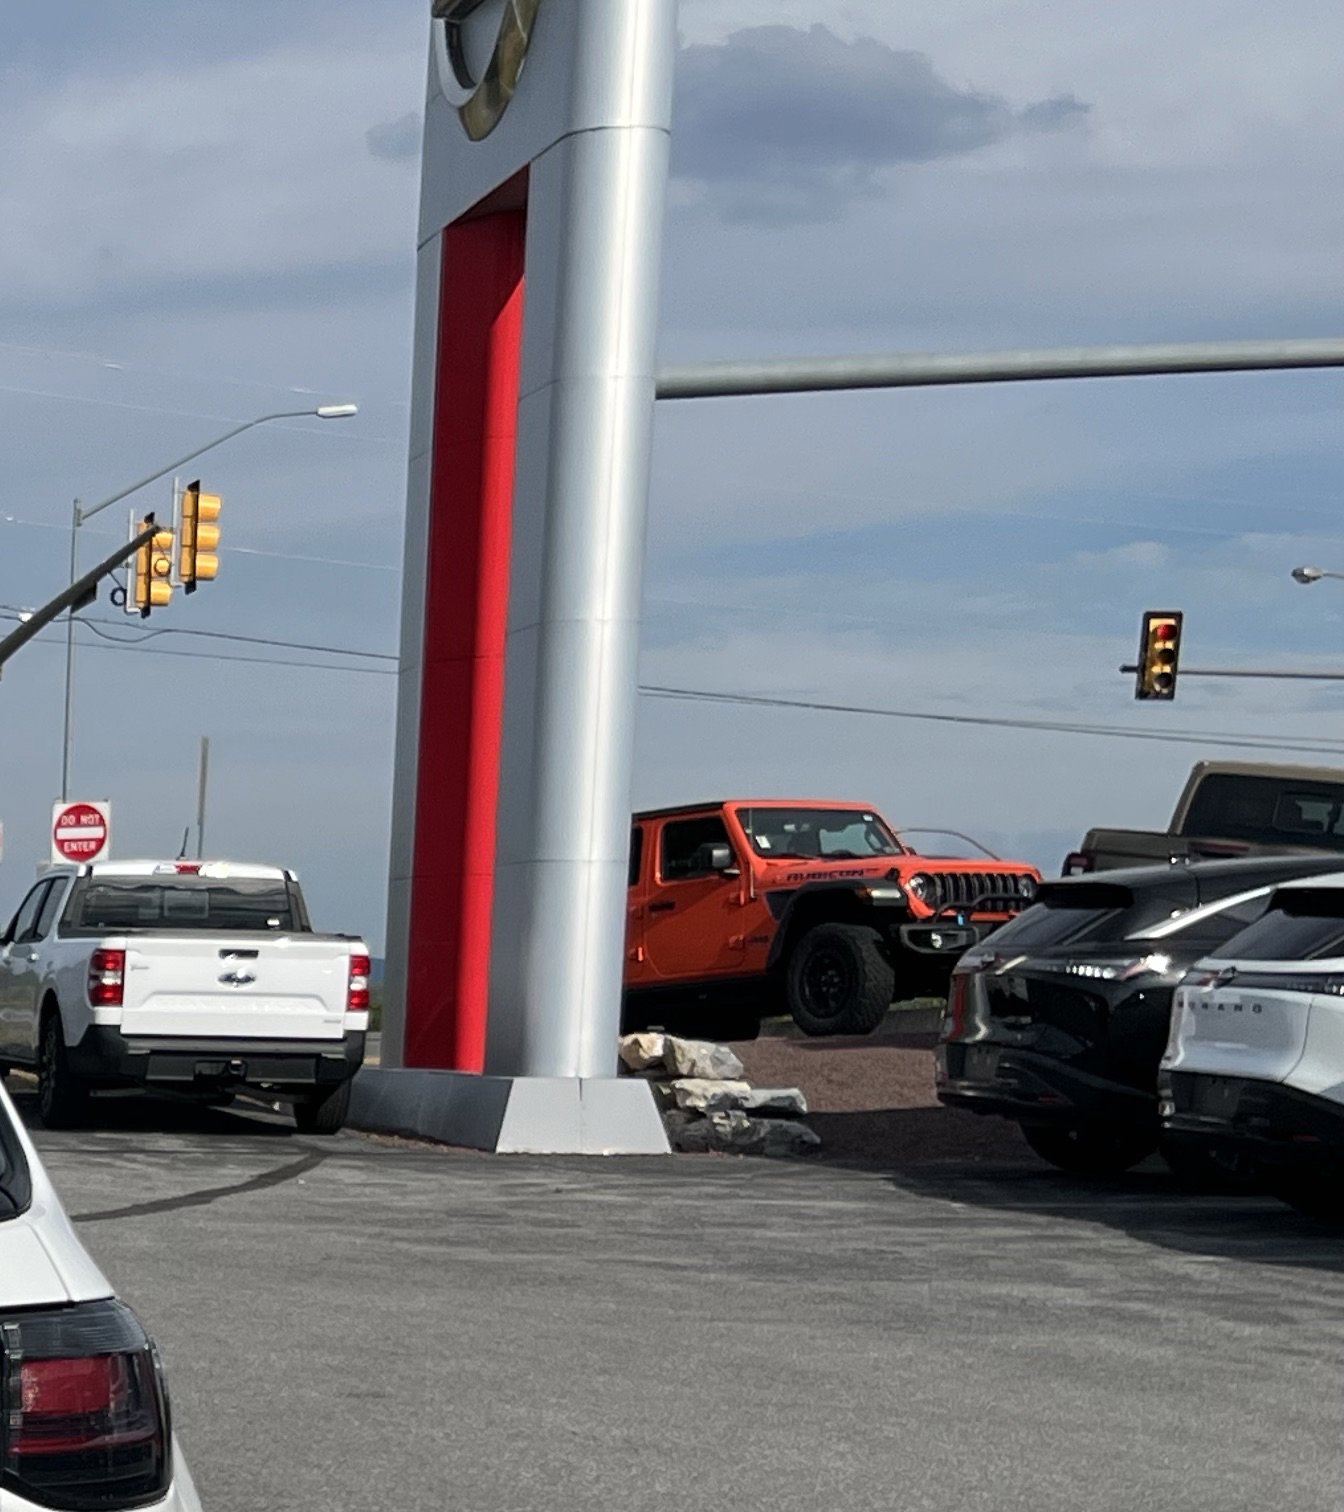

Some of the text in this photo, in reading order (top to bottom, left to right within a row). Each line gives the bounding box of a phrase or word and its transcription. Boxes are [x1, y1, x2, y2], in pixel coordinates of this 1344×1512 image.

[61, 814, 100, 826] DO NOT
[63, 841, 97, 852] ENTER
